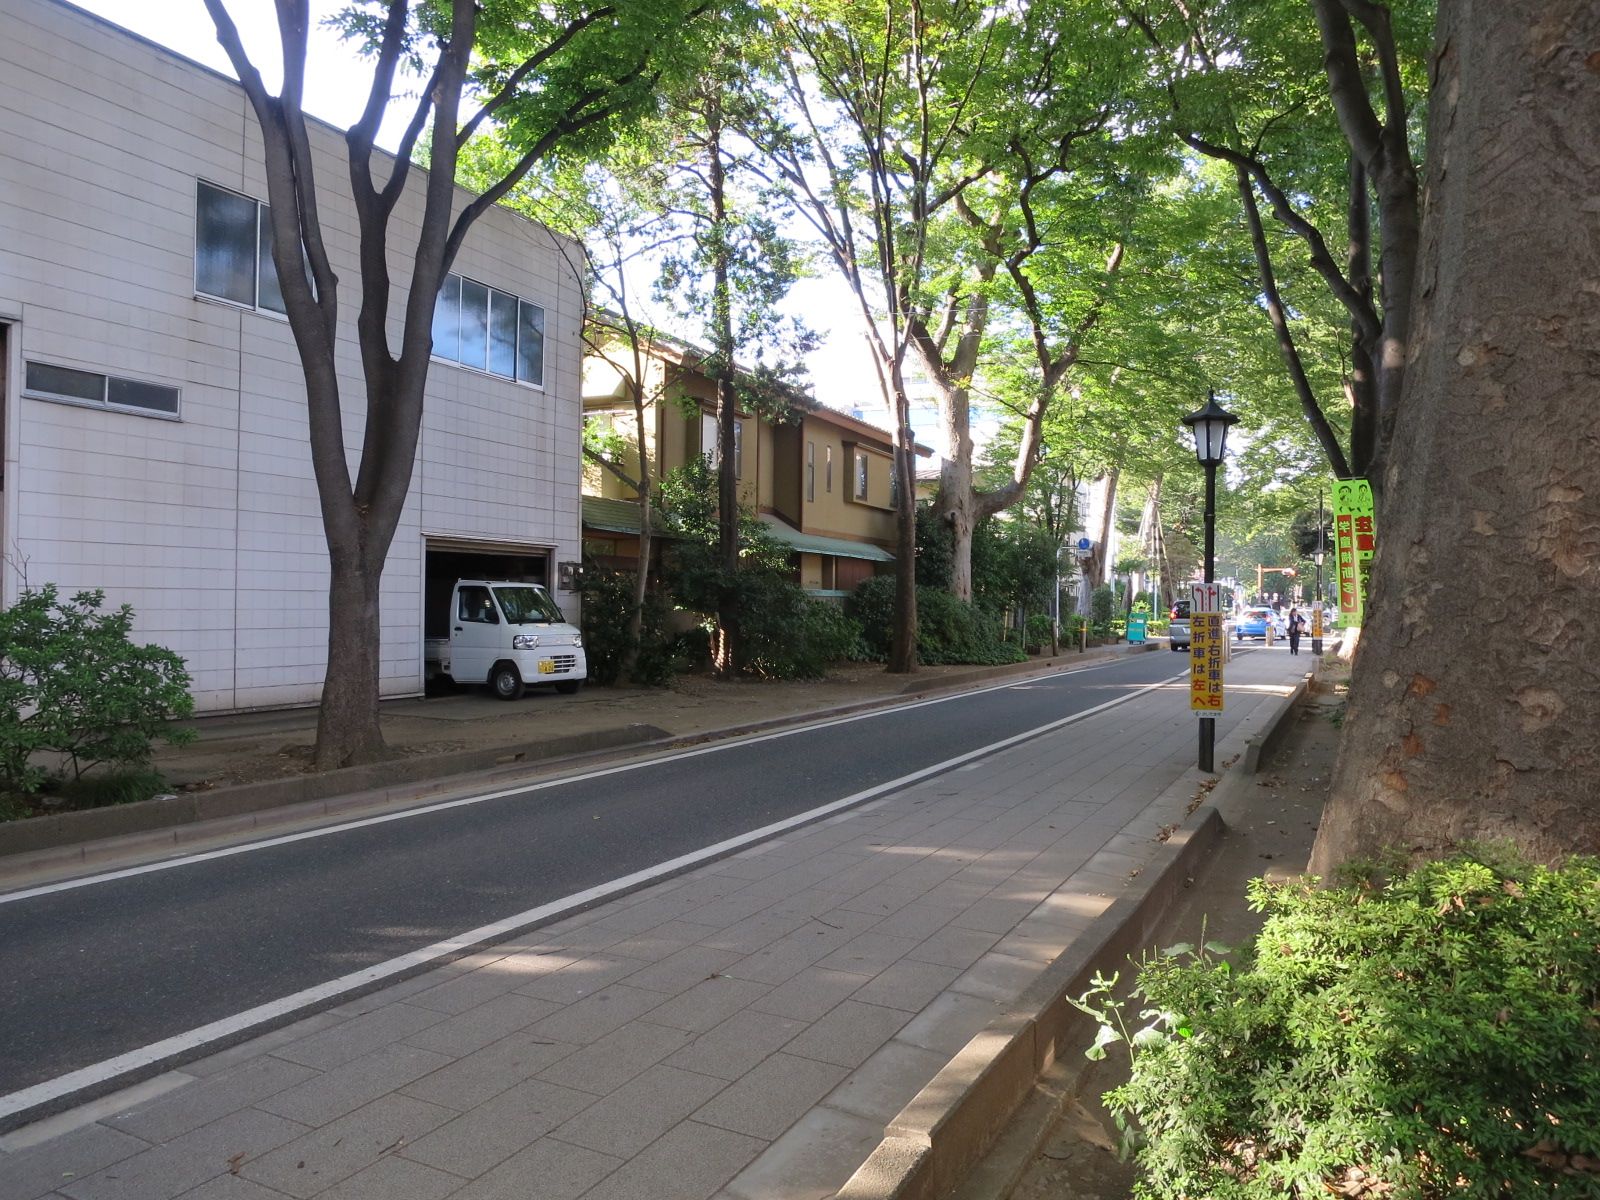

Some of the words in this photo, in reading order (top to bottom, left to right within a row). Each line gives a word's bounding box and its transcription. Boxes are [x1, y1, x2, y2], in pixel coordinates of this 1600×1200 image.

[1193, 616, 1206, 706] 左折車は左へ
[1208, 615, 1221, 707] 直進・右折車は右
